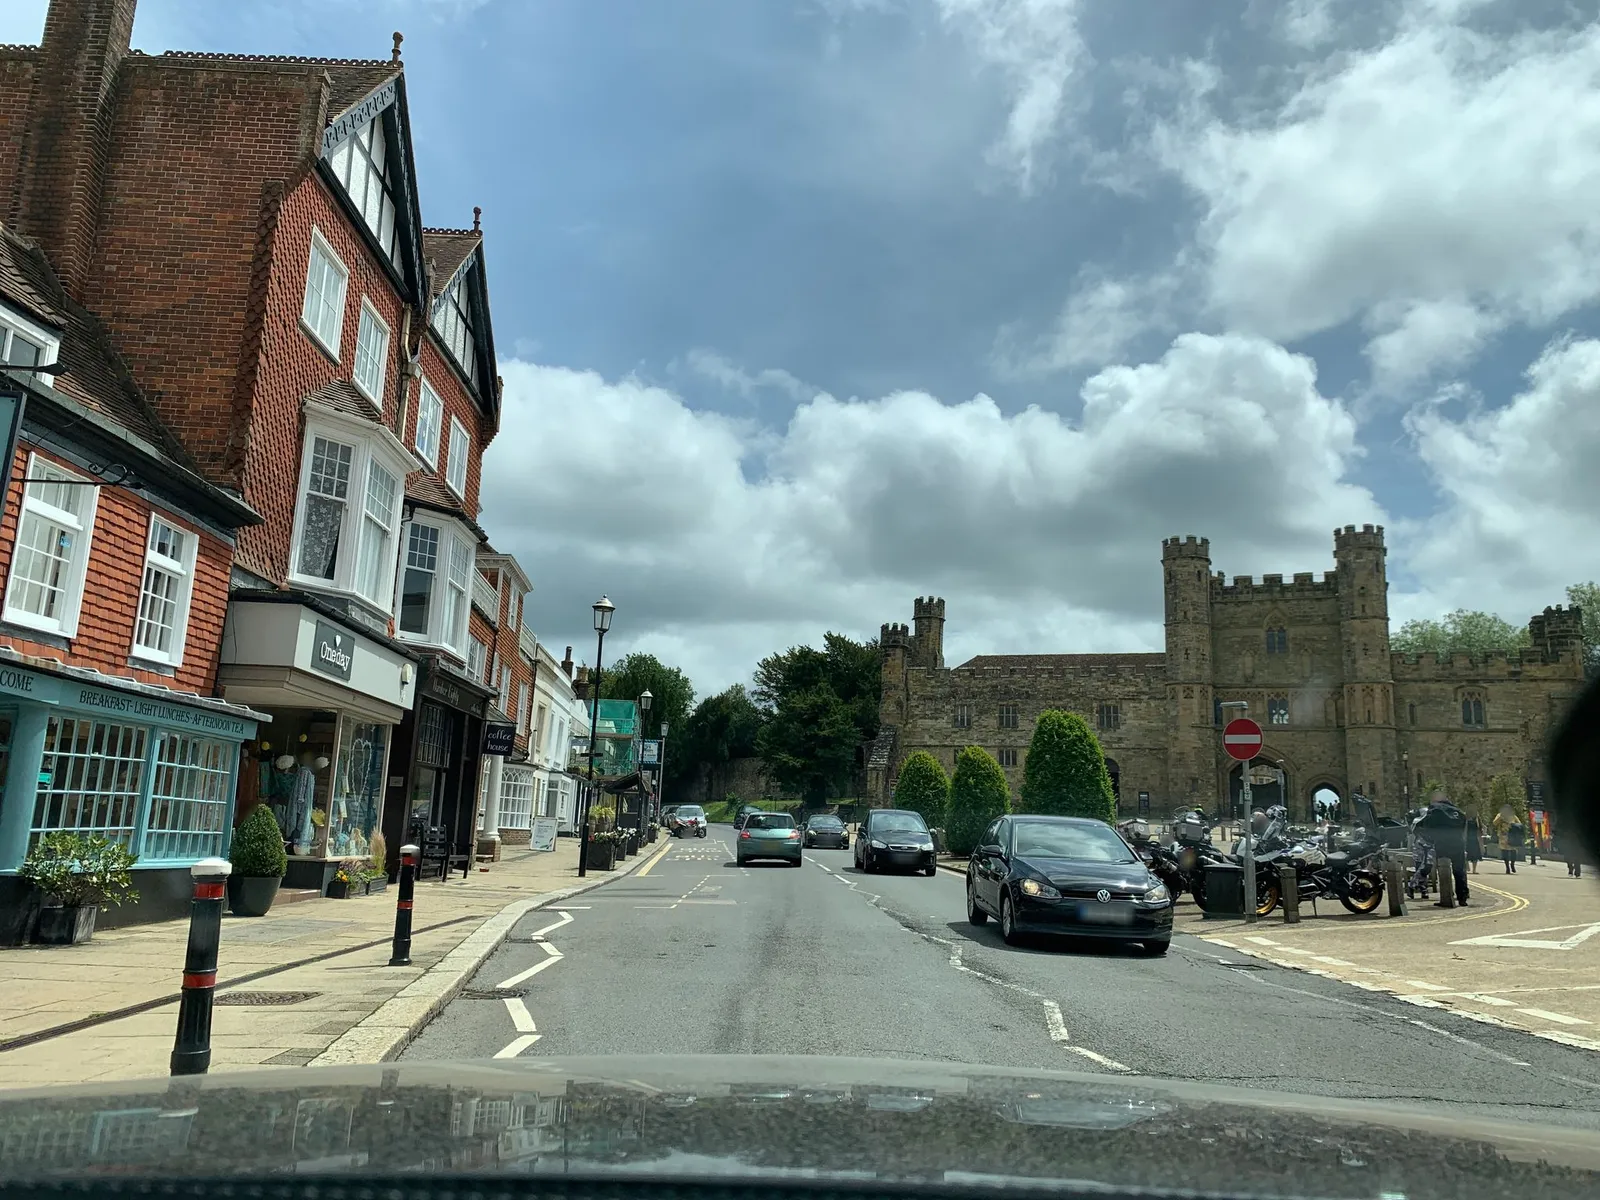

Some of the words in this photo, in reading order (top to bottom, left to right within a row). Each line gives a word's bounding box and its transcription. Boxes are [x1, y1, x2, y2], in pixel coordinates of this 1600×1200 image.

[320, 641, 351, 672] Oneday
[158, 706, 191, 724] LUNCHES
[231, 720, 244, 735] TEA
[487, 729, 512, 740] coffee
[487, 740, 509, 752] house
